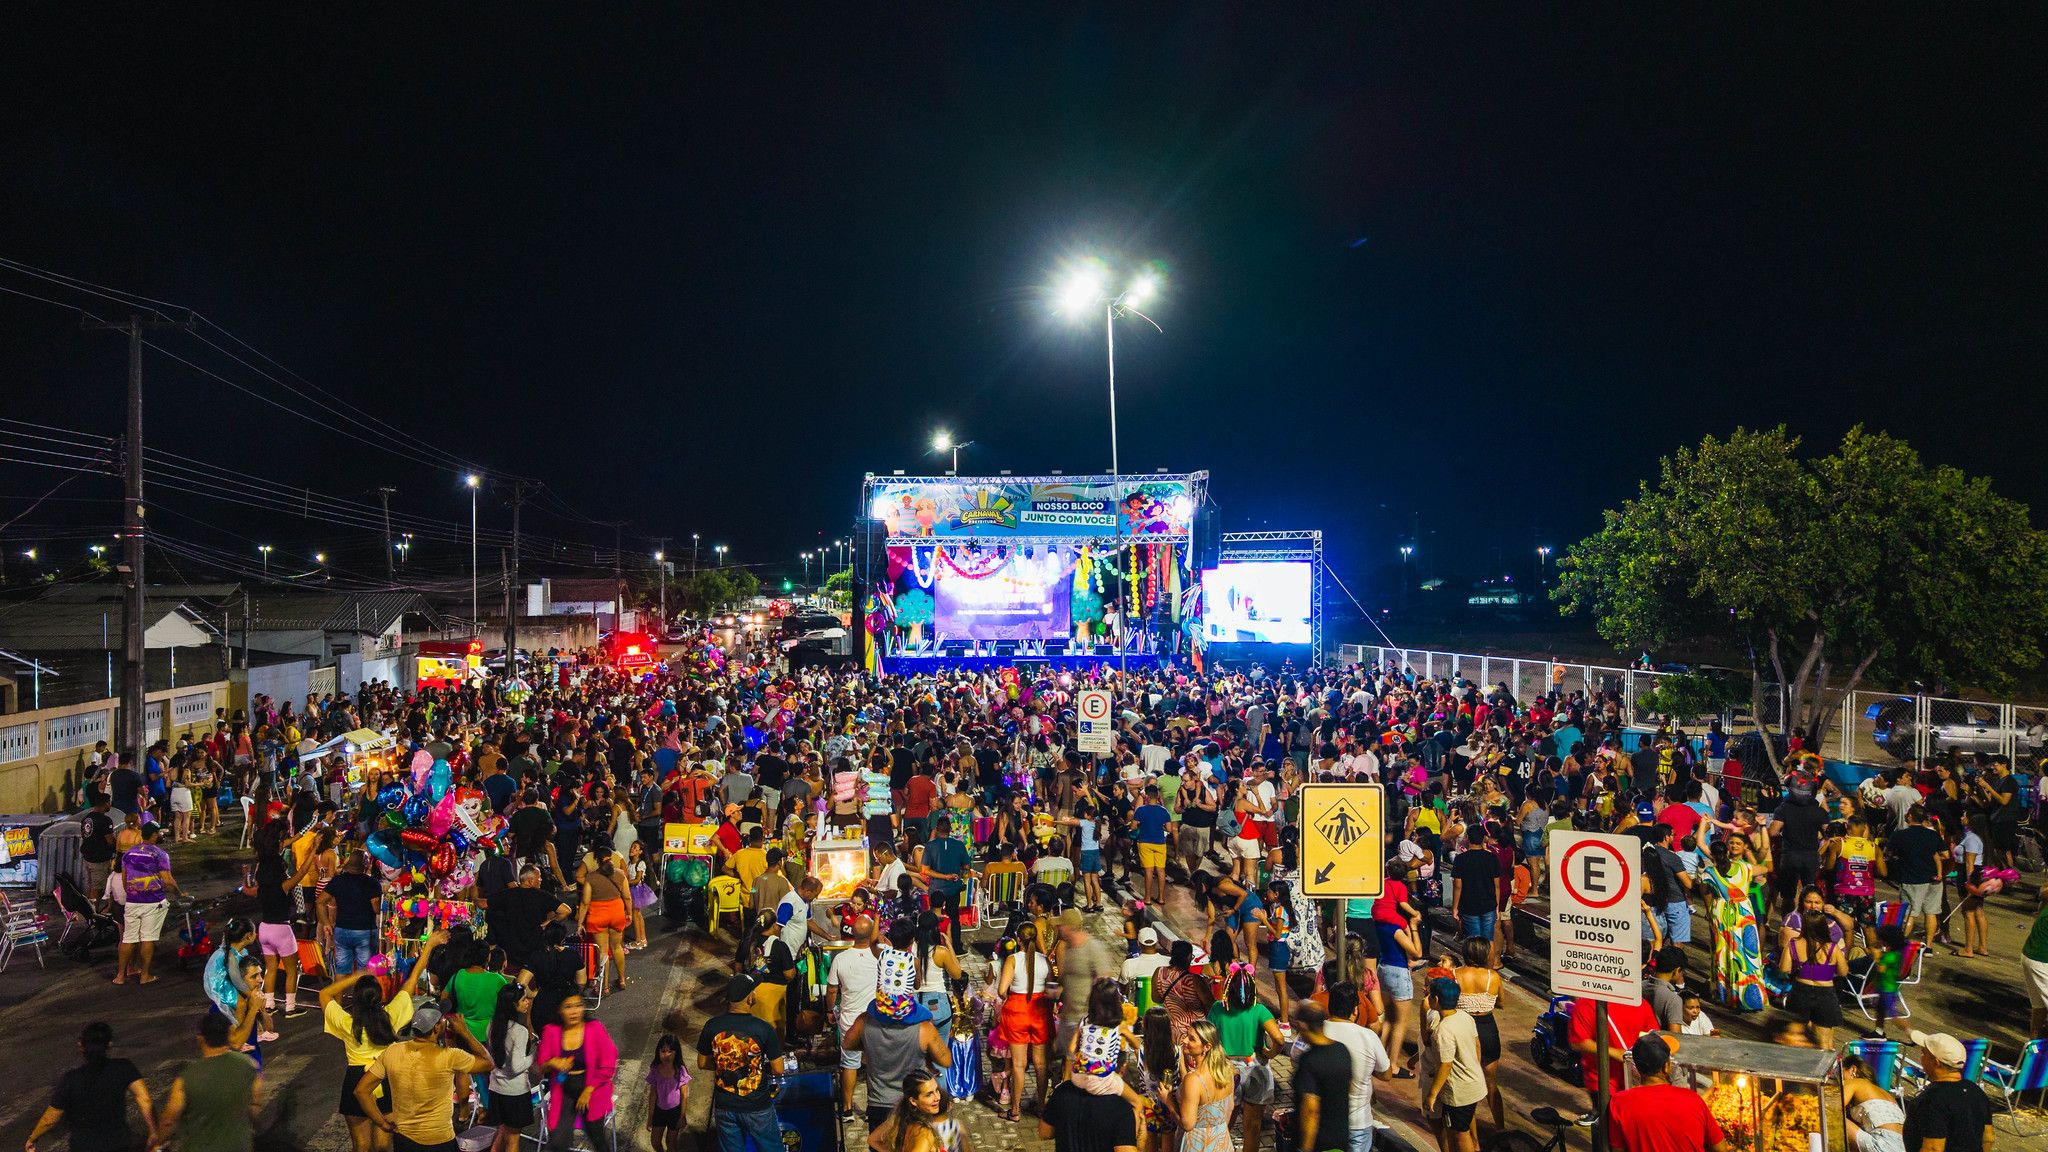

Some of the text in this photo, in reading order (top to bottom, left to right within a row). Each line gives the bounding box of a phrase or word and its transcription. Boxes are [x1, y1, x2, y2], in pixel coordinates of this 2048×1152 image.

[1036, 502, 1104, 511] NOSSO BLOCO
[962, 509, 1003, 521] CARNAVAL
[1024, 513, 1115, 525] JUNTO COM VOCÊ!
[1091, 700, 1099, 713] E
[1517, 761, 1531, 779] 43
[5, 828, 29, 842] EM
[8, 840, 35, 856] MA
[1583, 855, 1607, 893] E
[1559, 913, 1631, 931] EXCLUSIVO
[842, 924, 854, 935] CA
[1575, 929, 1615, 944] IDOSO
[1565, 950, 1625, 966] OBRIGATÓRIO
[1560, 959, 1631, 977] USO DO CARTÃO
[1582, 980, 1613, 991] 01 VAGA
